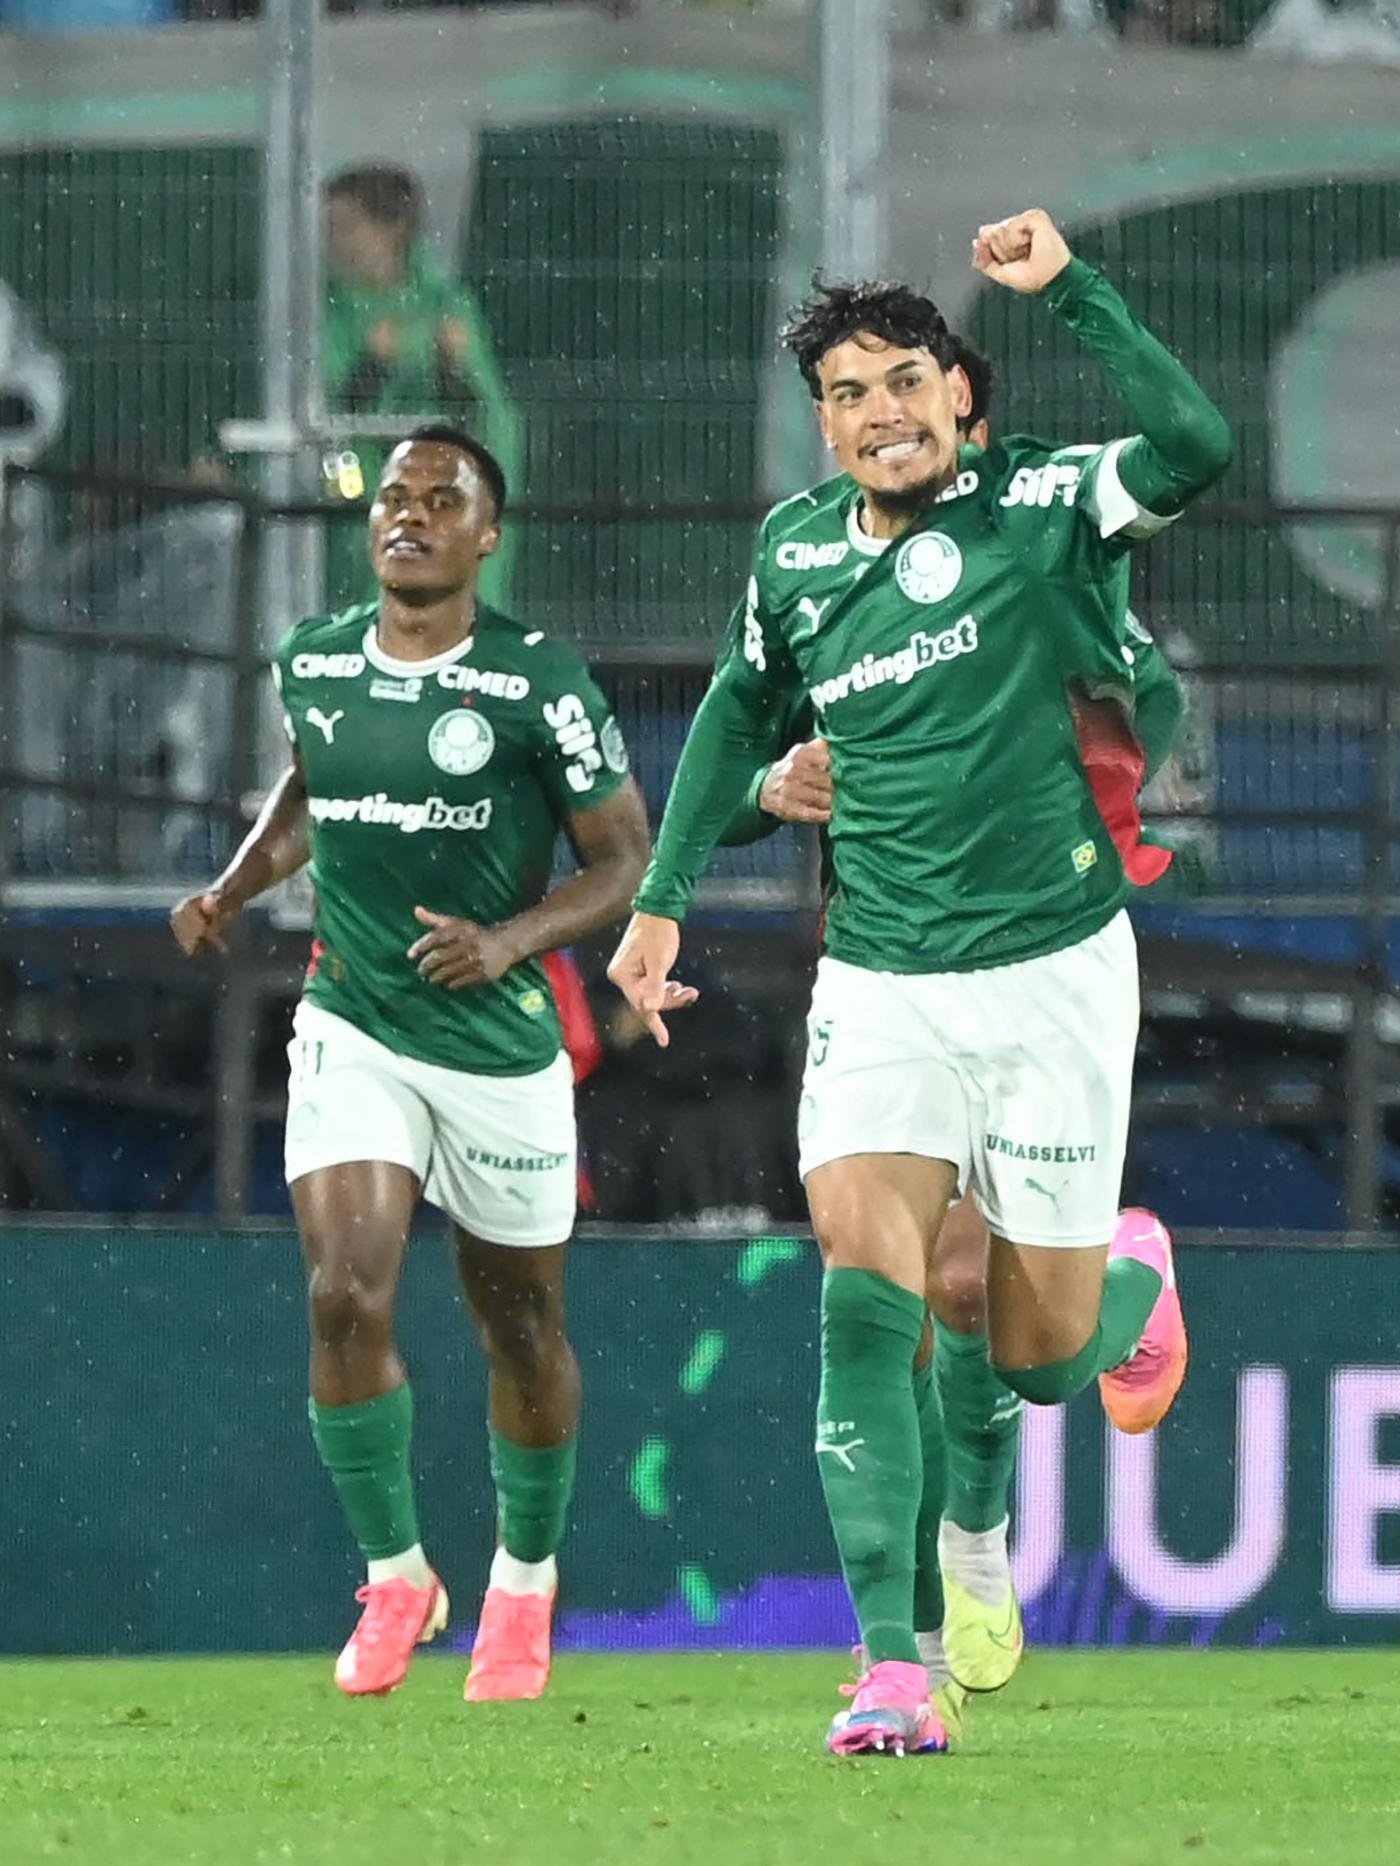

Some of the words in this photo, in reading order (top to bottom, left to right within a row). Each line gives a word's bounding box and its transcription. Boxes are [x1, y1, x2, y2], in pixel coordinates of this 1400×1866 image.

[776, 541, 849, 570] CIMED
[291, 654, 366, 678] CIMED
[809, 614, 978, 712] portingbet
[437, 664, 530, 700] CIMED
[308, 793, 492, 833] portingbet
[985, 1132, 1096, 1162] UNIASSELVI
